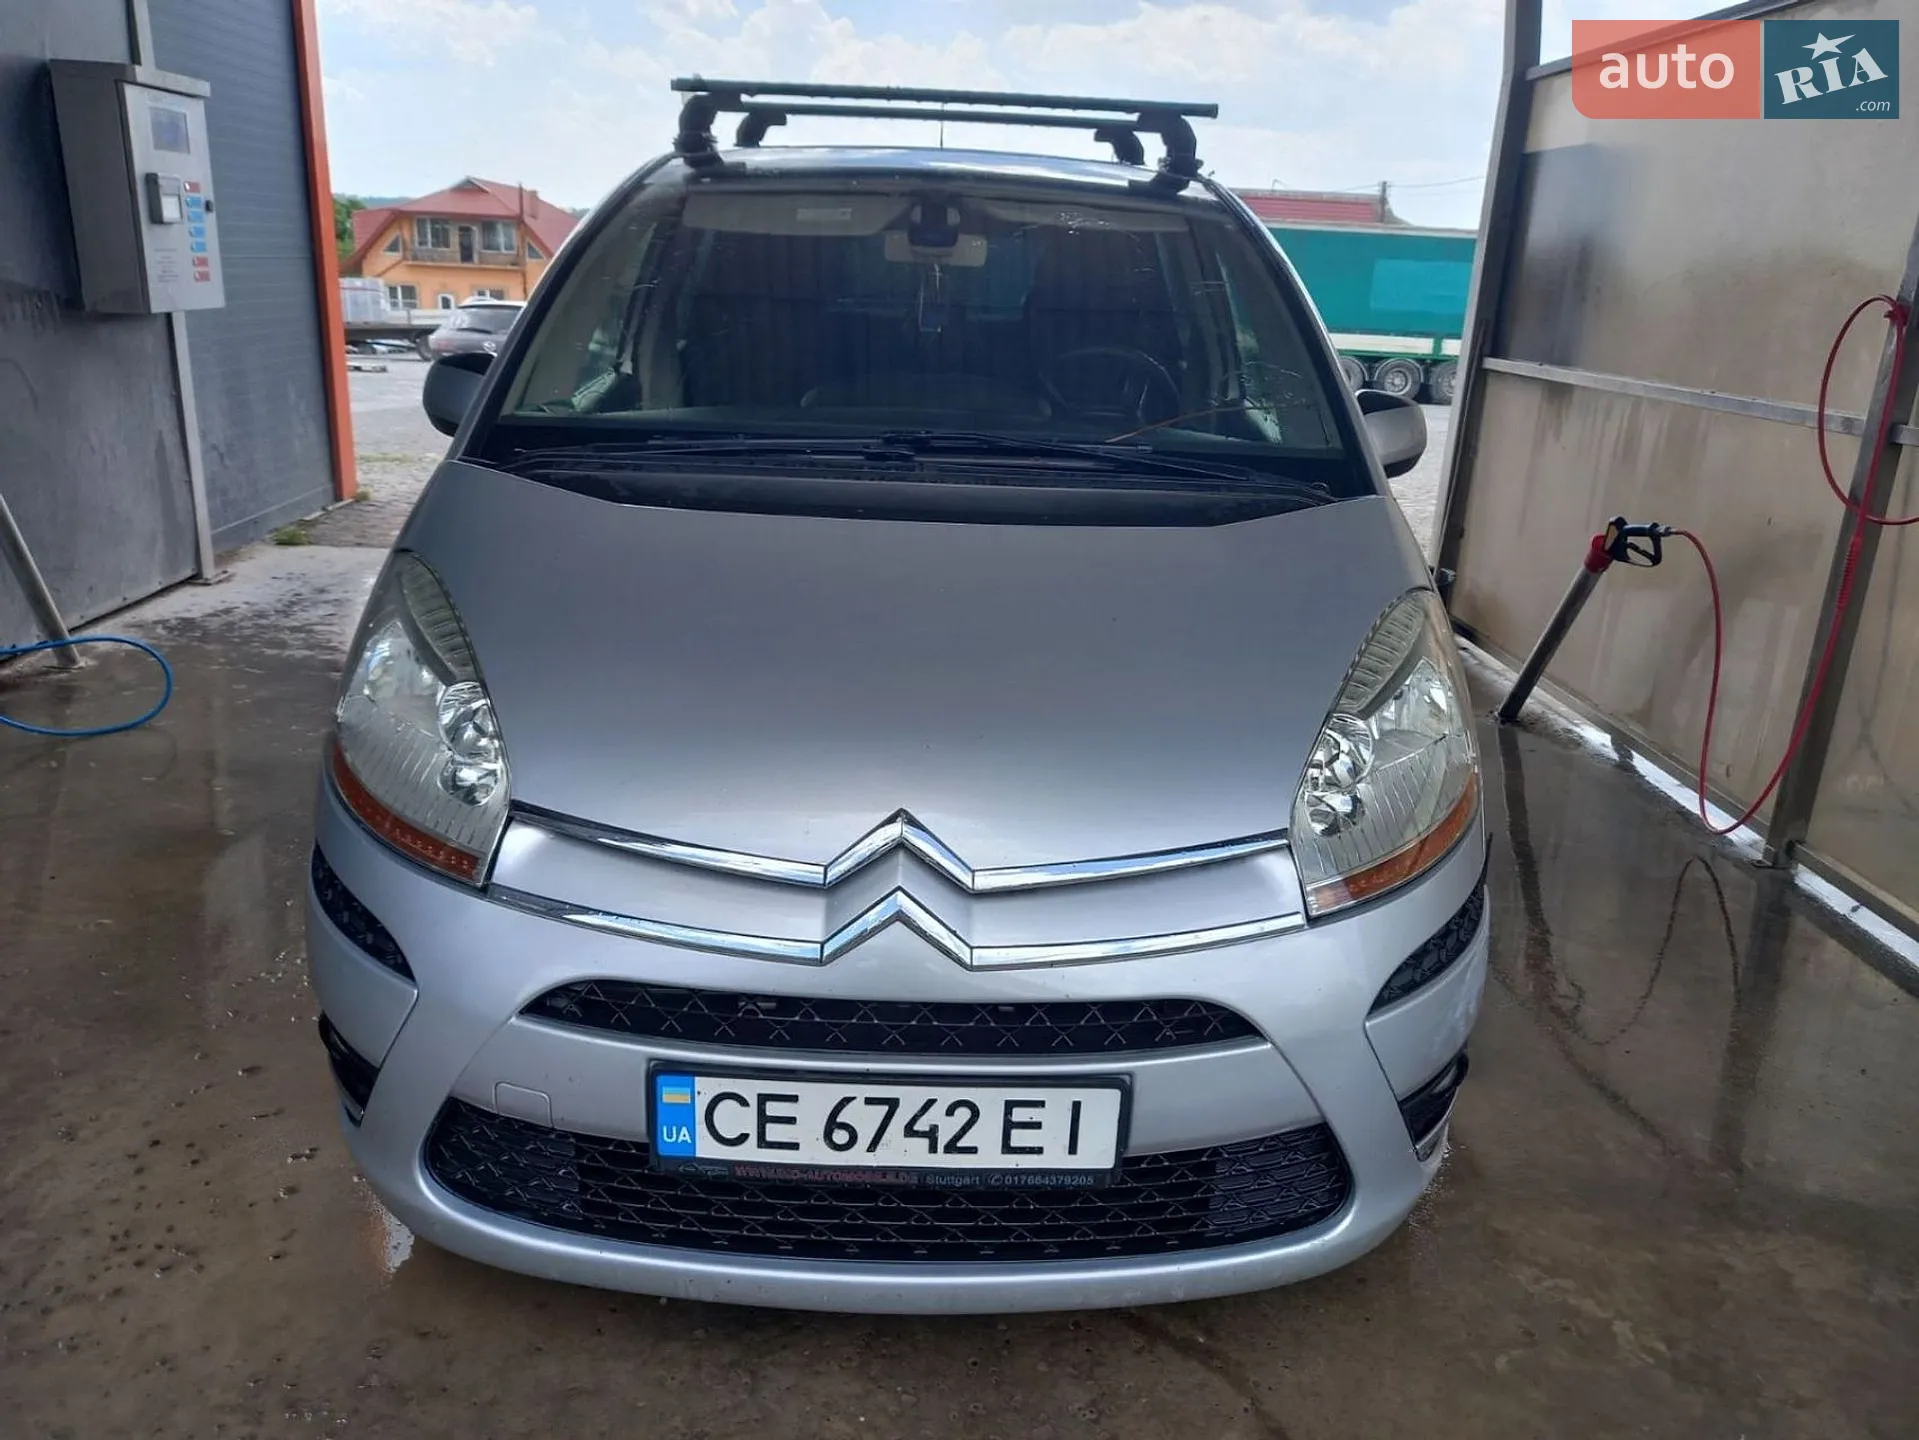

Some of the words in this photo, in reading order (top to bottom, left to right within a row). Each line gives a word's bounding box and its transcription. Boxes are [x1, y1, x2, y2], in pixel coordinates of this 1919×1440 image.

[704, 1091, 800, 1151] CE
[823, 1096, 981, 1155] 6742
[1001, 1099, 1082, 1155] EI
[663, 1126, 692, 1144] UA
[925, 1173, 980, 1186] Stuttgart
